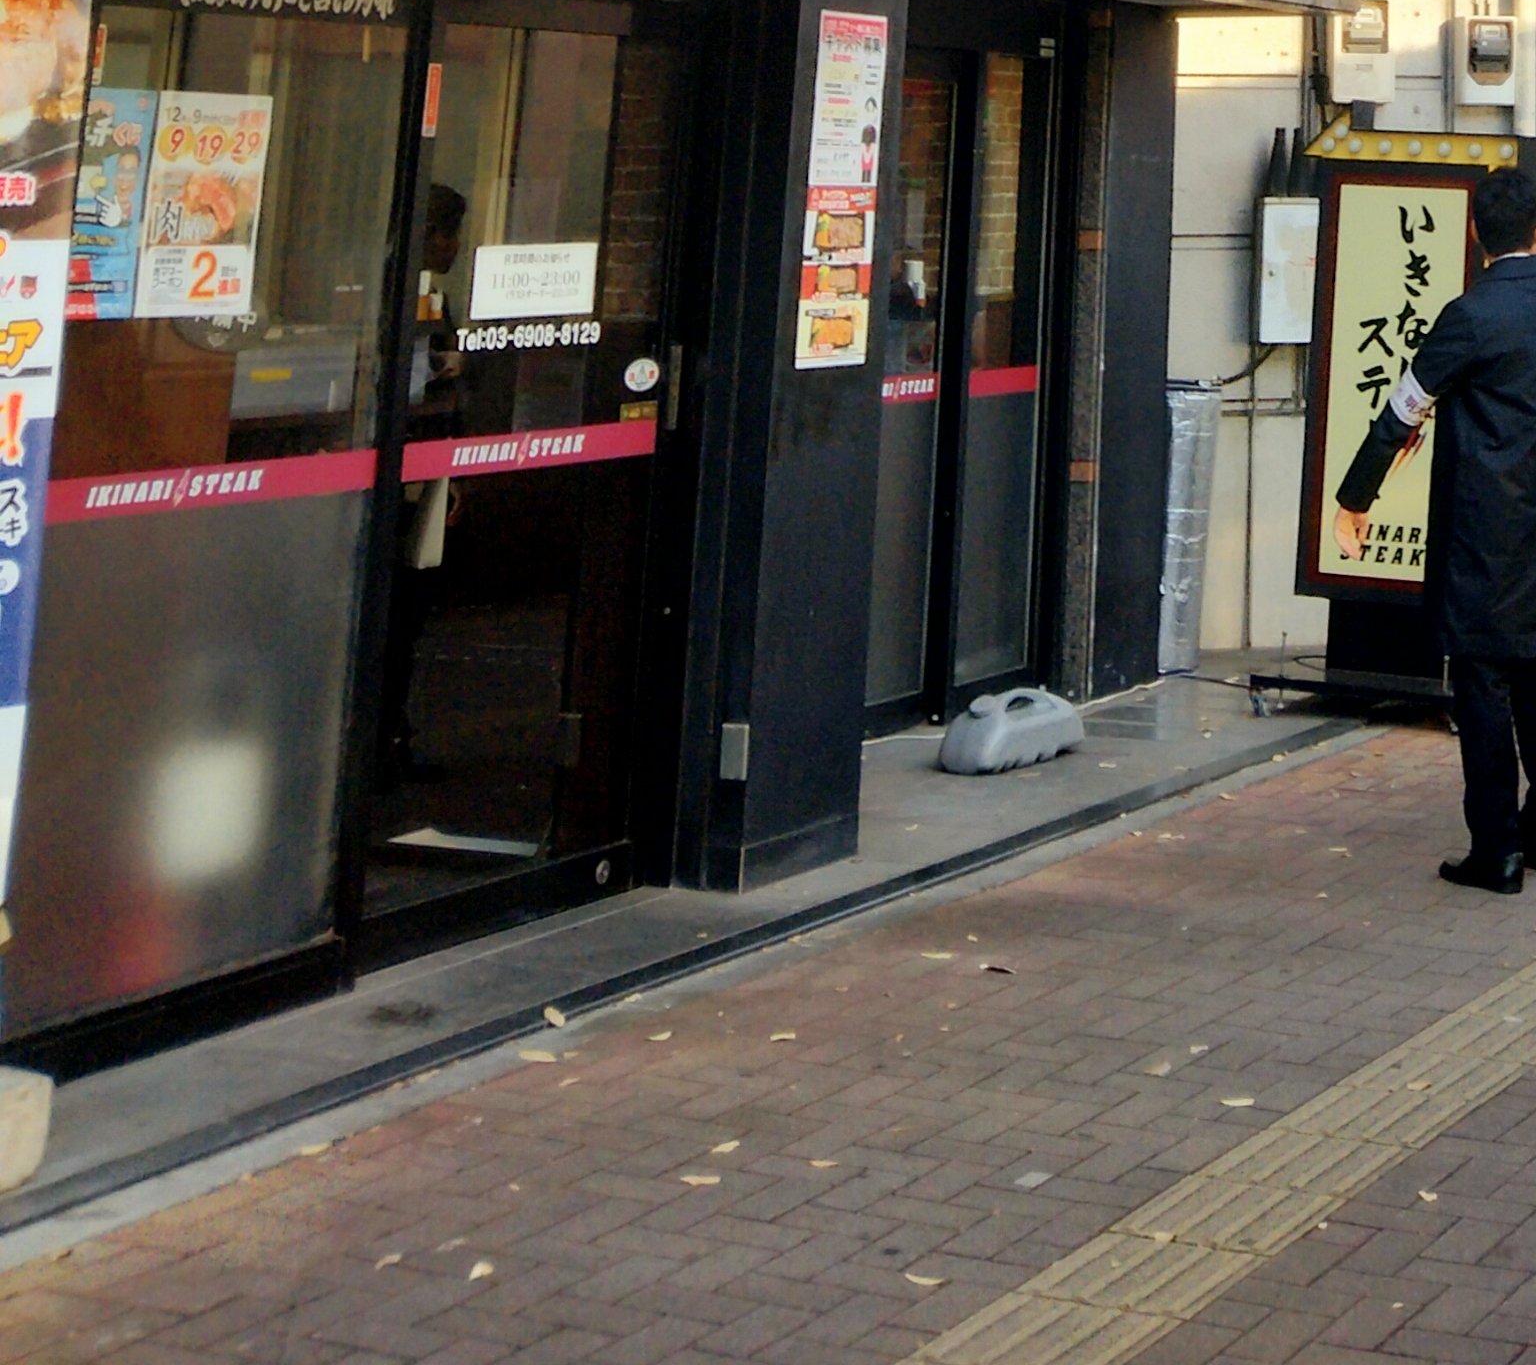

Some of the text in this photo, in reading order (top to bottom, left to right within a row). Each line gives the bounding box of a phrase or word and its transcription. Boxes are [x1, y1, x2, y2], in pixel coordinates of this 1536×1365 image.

[169, 128, 261, 157] 9 19 29
[188, 250, 218, 300] 2
[1396, 204, 1436, 381] いきな
[1356, 316, 1395, 410] ステ
[452, 434, 586, 467] IKINARI STEAK
[86, 468, 264, 509] IKINARI STEAK
[1355, 523, 1428, 546] INAR
